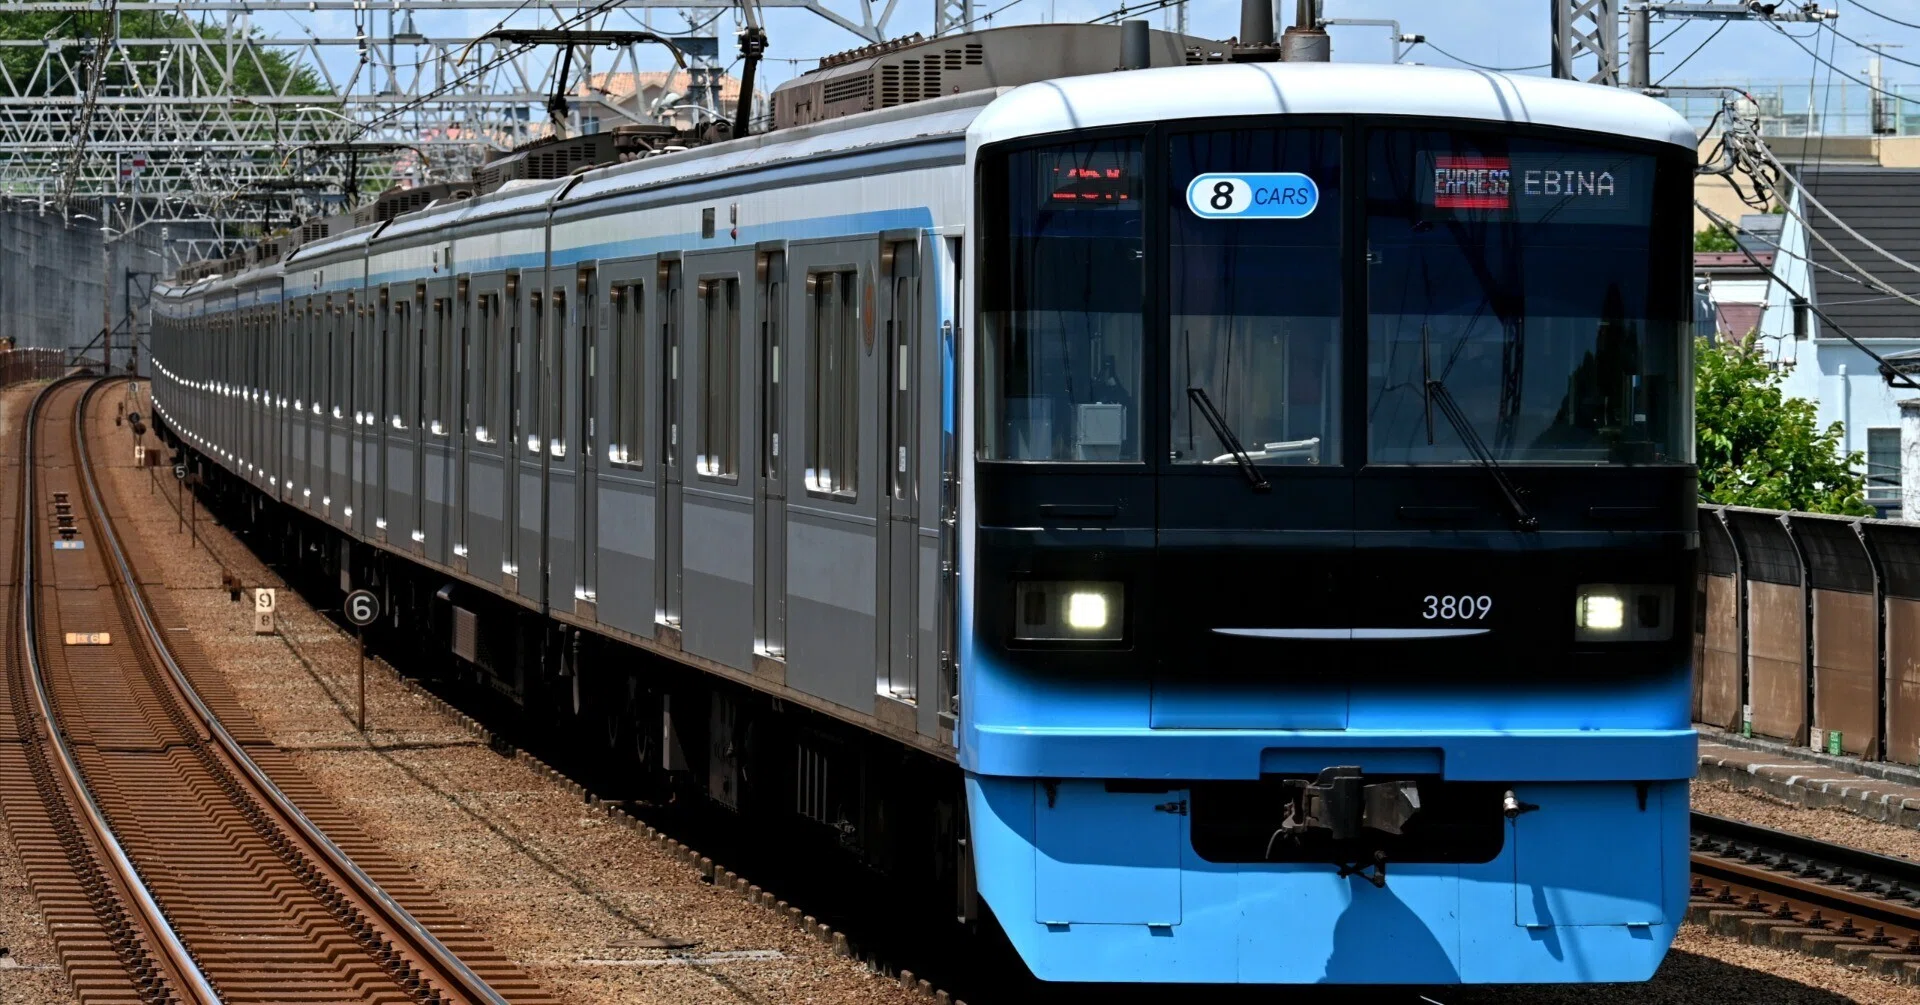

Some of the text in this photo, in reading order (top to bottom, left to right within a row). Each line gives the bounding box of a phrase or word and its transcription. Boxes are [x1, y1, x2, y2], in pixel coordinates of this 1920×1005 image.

[1434, 168, 1615, 196] EXPRESS EBINA
[1210, 181, 1309, 210] 8 CARS
[175, 465, 186, 479] 5
[259, 592, 272, 608] 9
[352, 595, 371, 621] 6
[1422, 595, 1492, 620] 3809
